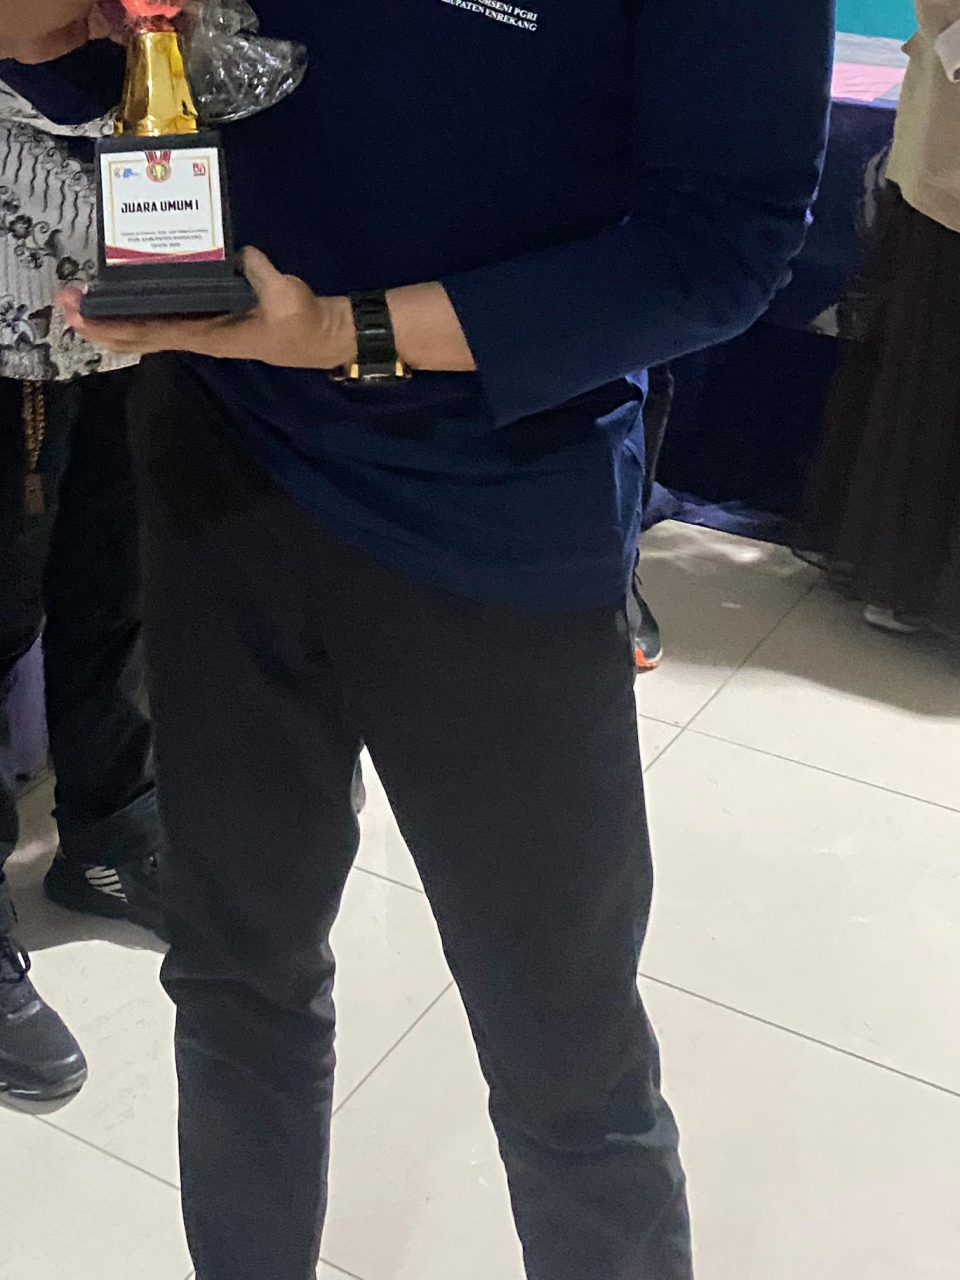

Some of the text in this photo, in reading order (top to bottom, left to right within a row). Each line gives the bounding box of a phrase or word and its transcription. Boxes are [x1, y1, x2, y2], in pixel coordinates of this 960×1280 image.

[485, 8, 538, 32] ENREKANG
[513, 7, 538, 21] PGRI
[121, 199, 199, 214] JUARA UMUM I
[85, 865, 129, 903] NIK
